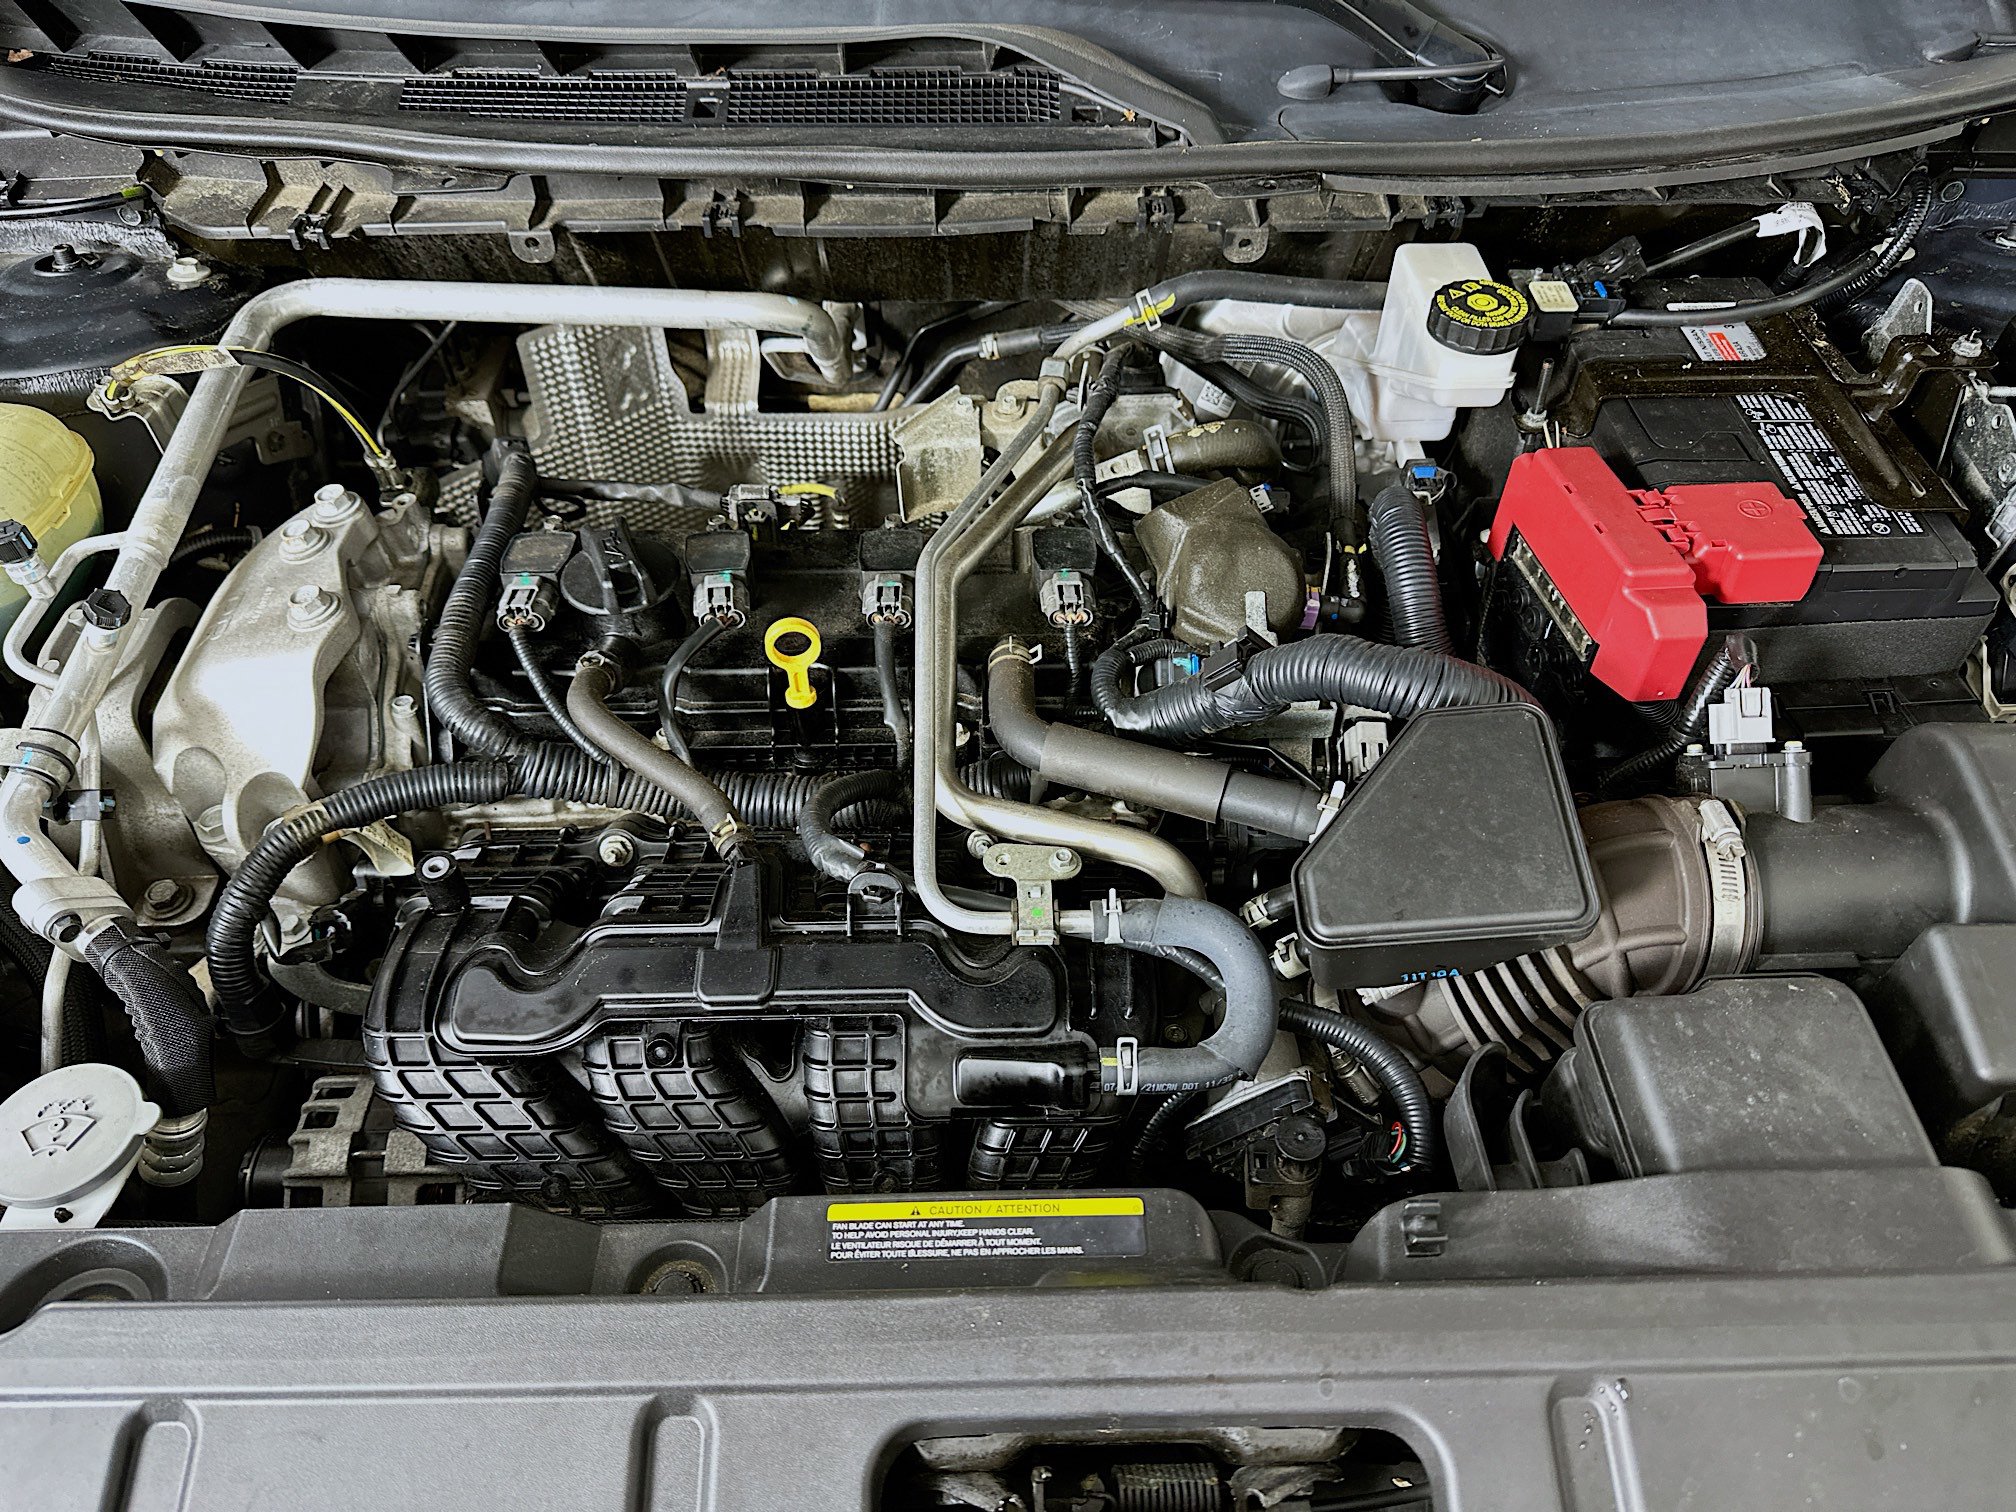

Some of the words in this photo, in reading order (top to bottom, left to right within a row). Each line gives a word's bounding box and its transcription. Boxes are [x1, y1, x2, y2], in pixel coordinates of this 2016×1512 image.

[930, 1205, 982, 1215] CAUTION
[996, 1204, 1060, 1213] ATTENTION
[842, 1241, 891, 1250] VENTILATEUR
[935, 1238, 977, 1247] DÉMARRER
[830, 1251, 853, 1259] POUR
[854, 1249, 880, 1259] ÉVITER
[992, 1247, 1040, 1255] APPROCHER
